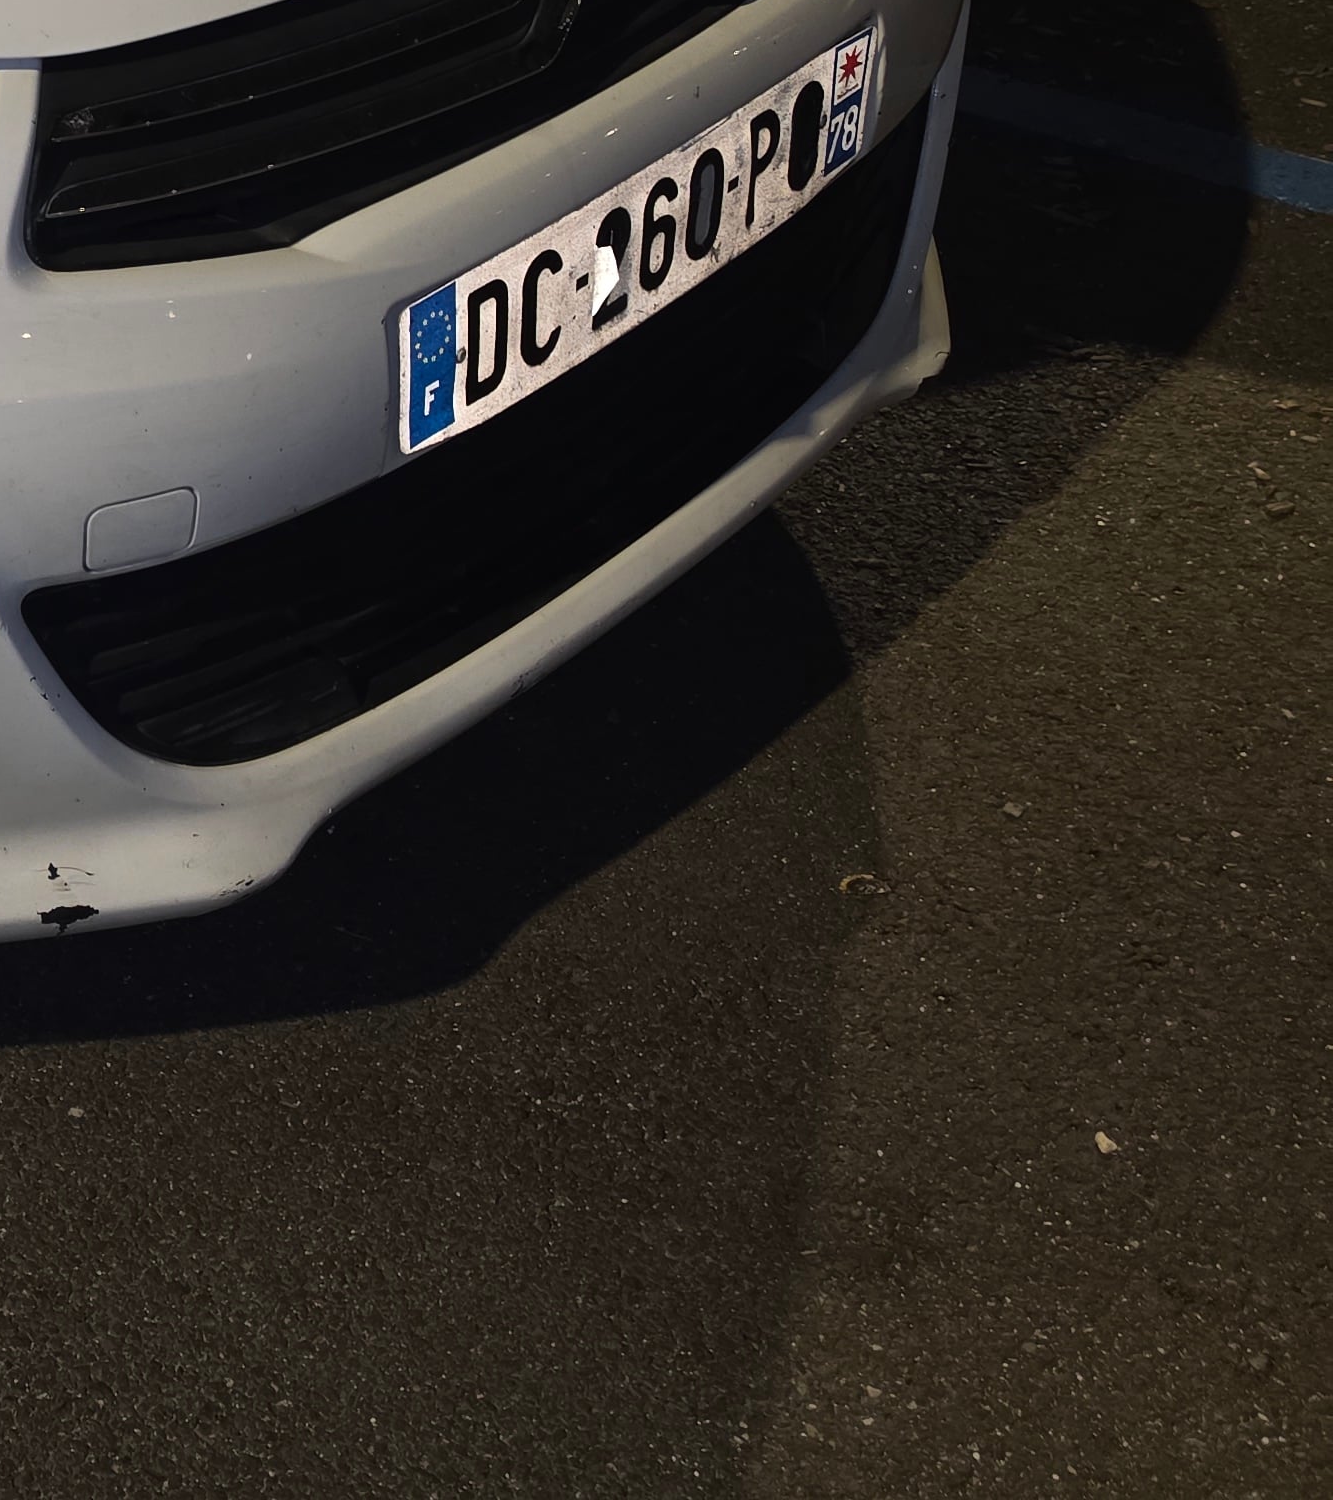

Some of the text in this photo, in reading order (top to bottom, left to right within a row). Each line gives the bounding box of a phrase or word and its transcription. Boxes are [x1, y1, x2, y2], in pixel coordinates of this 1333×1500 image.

[827, 104, 859, 165] 78
[465, 79, 825, 407] DC-260-P
[423, 380, 441, 418] F
